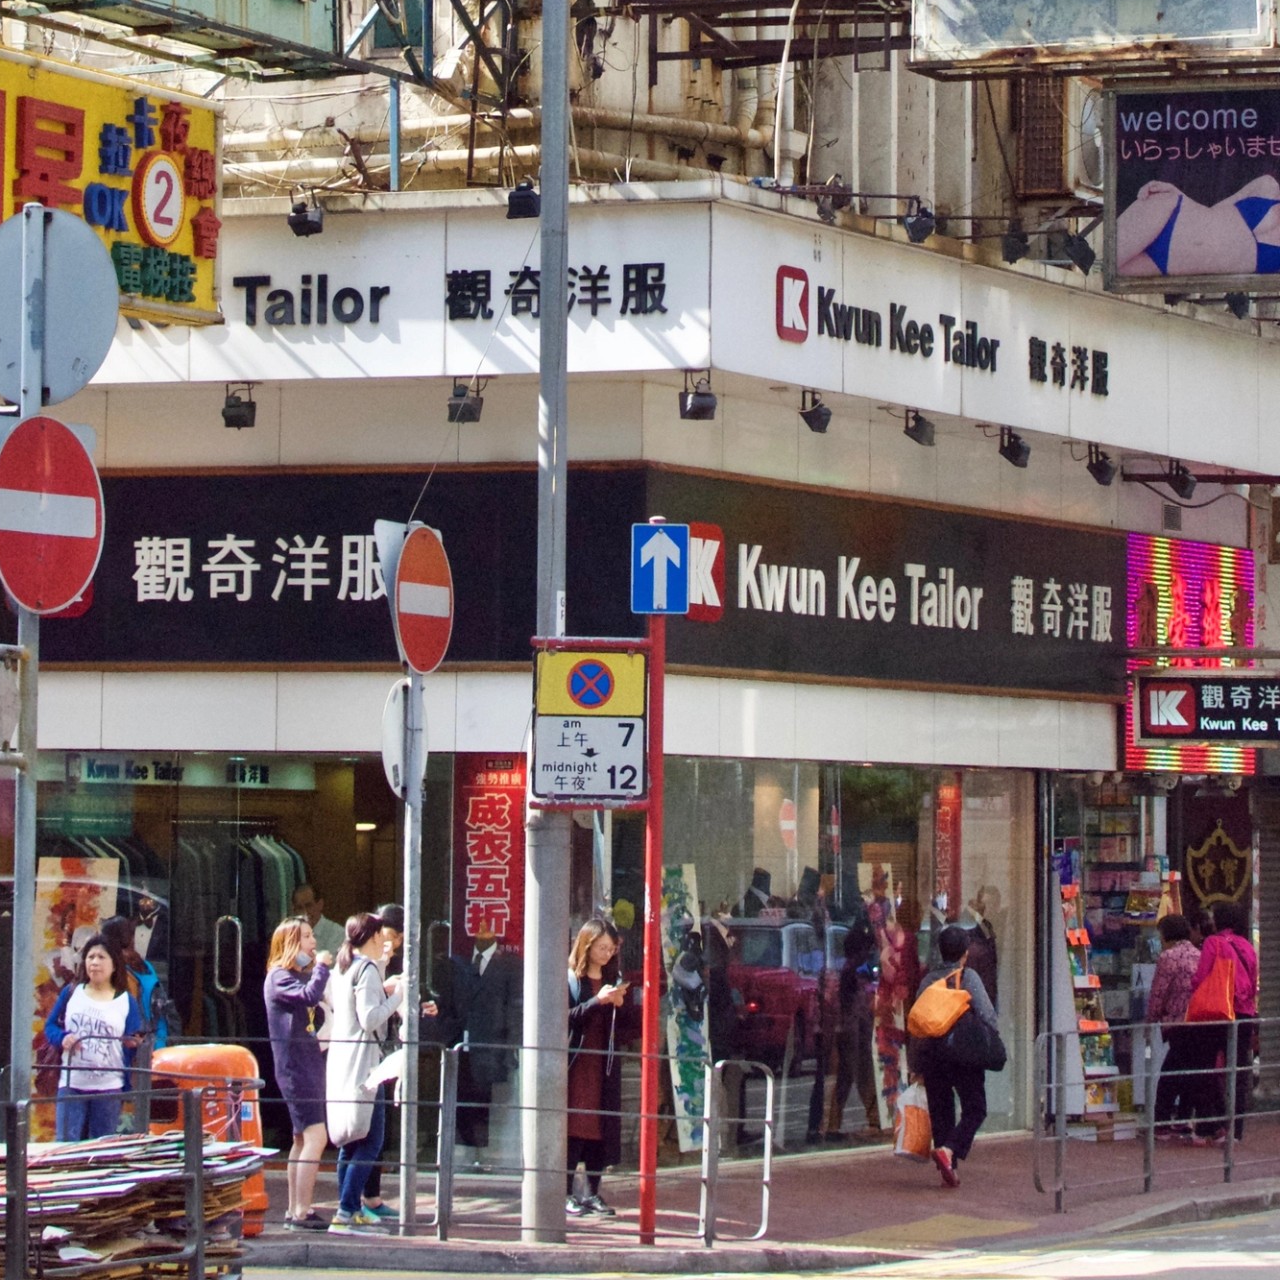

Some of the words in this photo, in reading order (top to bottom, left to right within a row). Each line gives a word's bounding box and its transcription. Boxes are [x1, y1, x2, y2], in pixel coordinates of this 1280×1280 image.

[1121, 105, 1258, 132] welcome
[152, 170, 173, 226] 2
[233, 274, 393, 326] Tailor
[445, 263, 669, 320] 觀奇洋服
[817, 286, 882, 347] Kwun
[890, 303, 934, 357] Kee
[939, 314, 1000, 373] Tailor
[1029, 337, 1109, 396] 觀奇洋服
[132, 535, 395, 602] 觀奇洋服
[738, 543, 826, 617] Kwun
[837, 555, 896, 622] Kee
[904, 563, 983, 630] Tailor
[1010, 575, 1113, 643] 觀奇洋服
[557, 733, 588, 748] 上午
[563, 720, 581, 728] am
[618, 723, 635, 747] 7
[1201, 717, 1235, 731] Kwun
[1242, 717, 1268, 731] Kee
[542, 761, 597, 774] midnight
[607, 766, 637, 790] 12
[554, 775, 587, 791] 午夜
[465, 793, 511, 937] 成衣五折
